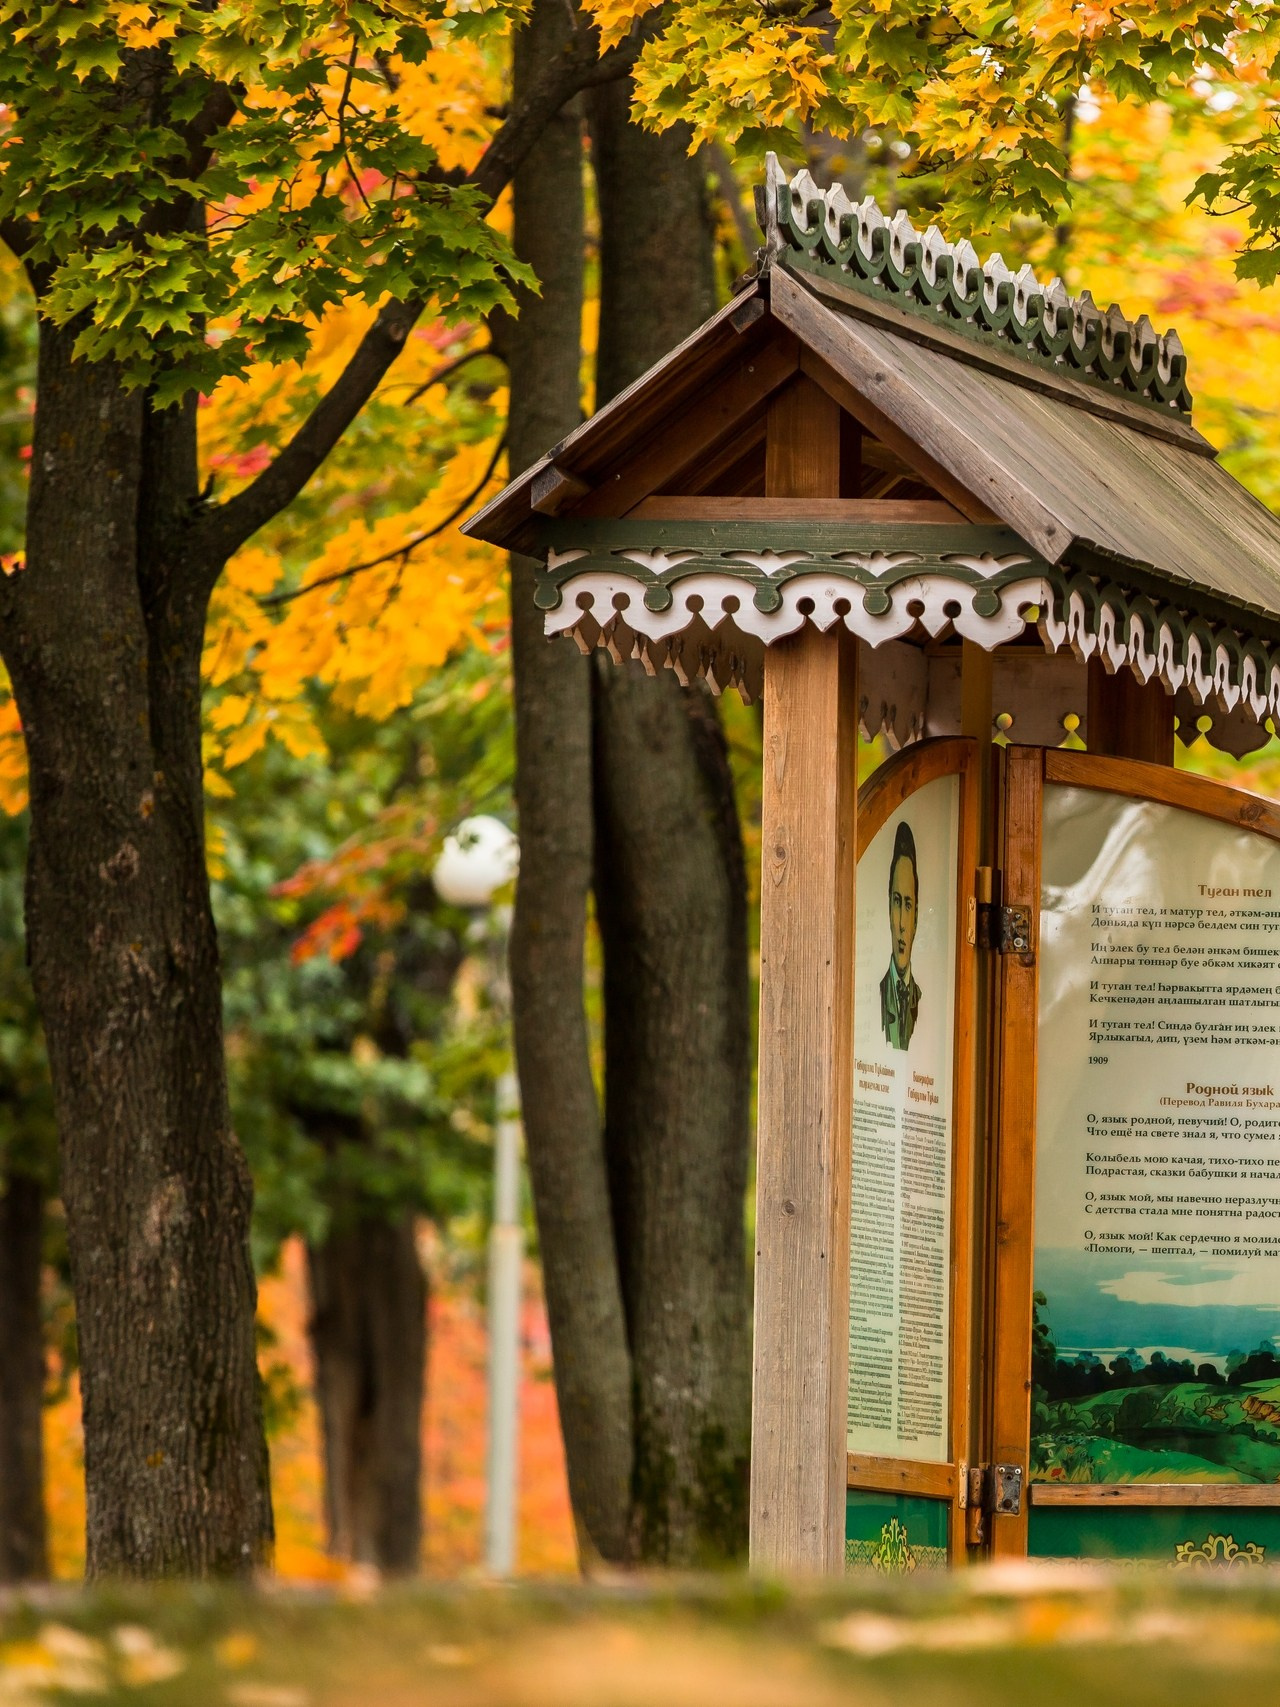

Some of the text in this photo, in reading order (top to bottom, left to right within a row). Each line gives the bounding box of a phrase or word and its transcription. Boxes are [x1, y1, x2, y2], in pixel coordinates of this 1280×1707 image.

[1197, 884, 1272, 900] Туган тел
[1091, 903, 1101, 915] И
[1135, 907, 1158, 917] тел,
[1159, 908, 1168, 916] и
[1169, 908, 1204, 920] матур
[1205, 909, 1228, 919] тел,
[1141, 920, 1162, 931] күп
[1164, 921, 1196, 932] нәрсә
[1197, 919, 1238, 931] белдем
[1239, 922, 1260, 931] син
[1090, 942, 1108, 954] Иң
[1109, 945, 1134, 953] элек
[1136, 943, 1150, 956] бу
[1151, 946, 1171, 954] тел
[1172, 944, 1205, 955] белән
[1207, 947, 1241, 956] әнкәм
[1137, 958, 1179, 970] төннәр
[1180, 957, 1200, 970] буе
[1201, 958, 1235, 968] әбкәм
[1237, 961, 1276, 969] хикәят
[1089, 980, 1099, 990] И
[1100, 983, 1132, 994] туган
[1134, 982, 1156, 992] тел!
[1157, 982, 1223, 995] Һәрвакытта
[1225, 986, 1273, 997] ярдәмең
[1089, 993, 1155, 1005] Кечкенәдән
[1157, 997, 1227, 1006] аңлашылган
[1088, 1018, 1098, 1029] И
[1100, 1021, 1131, 1032] туган
[1133, 1020, 1155, 1030] тел!
[1157, 1020, 1193, 1032] Синдә
[1234, 1024, 1250, 1033] иң
[1251, 1025, 1277, 1033] элек
[1088, 1031, 1154, 1044] Ярлыкагыл,
[1155, 1035, 1181, 1045] дип,
[1182, 1036, 1209, 1047] үзем
[1210, 1034, 1232, 1045] һәм
[1088, 1055, 1109, 1065] 1909
[1186, 1082, 1274, 1098] Родной язык
[1159, 1096, 1206, 1109] (Перевод
[1208, 1097, 1244, 1108] Равиля
[1086, 1113, 1099, 1125] О,
[1101, 1116, 1128, 1124] язык
[1130, 1116, 1176, 1127] родной,
[1177, 1116, 1228, 1129] певучий!
[1229, 1116, 1242, 1129] О,
[1086, 1126, 1108, 1137] Что
[1110, 1127, 1133, 1138] ещё
[1134, 1130, 1148, 1138] на
[1150, 1130, 1180, 1139] свете
[1181, 1130, 1207, 1139] знал
[1208, 1131, 1219, 1141] я,
[1221, 1132, 1242, 1140] что
[1243, 1132, 1276, 1143] сумел
[1085, 1152, 1142, 1163] Колыбель
[1143, 1156, 1169, 1164] мою
[1171, 1156, 1206, 1166] качая,
[1207, 1157, 1265, 1167] тихо-тихо
[1085, 1165, 1148, 1179] Подрастая,
[1149, 1169, 1186, 1177] сказки
[1188, 1167, 1238, 1181] бабушки
[1240, 1171, 1248, 1179] я
[1084, 1191, 1098, 1203] О,
[1099, 1193, 1127, 1202] язык
[1128, 1193, 1155, 1204] мой,
[1156, 1195, 1174, 1203] мы
[1176, 1195, 1223, 1204] навечно
[1084, 1203, 1094, 1214] С
[1095, 1206, 1137, 1215] детства
[1138, 1207, 1169, 1216] стала
[1171, 1208, 1193, 1217] мне
[1195, 1209, 1243, 1217] понятна
[1084, 1229, 1097, 1241] О,
[1098, 1232, 1126, 1241] язык
[1127, 1231, 1154, 1241] мой!
[1156, 1231, 1177, 1242] Как
[1179, 1234, 1232, 1245] сердечно
[1233, 1235, 1241, 1243] я
[1083, 1242, 1136, 1255] «Помоги,
[1151, 1247, 1196, 1257] шептал,
[1211, 1247, 1262, 1260] помилуй
